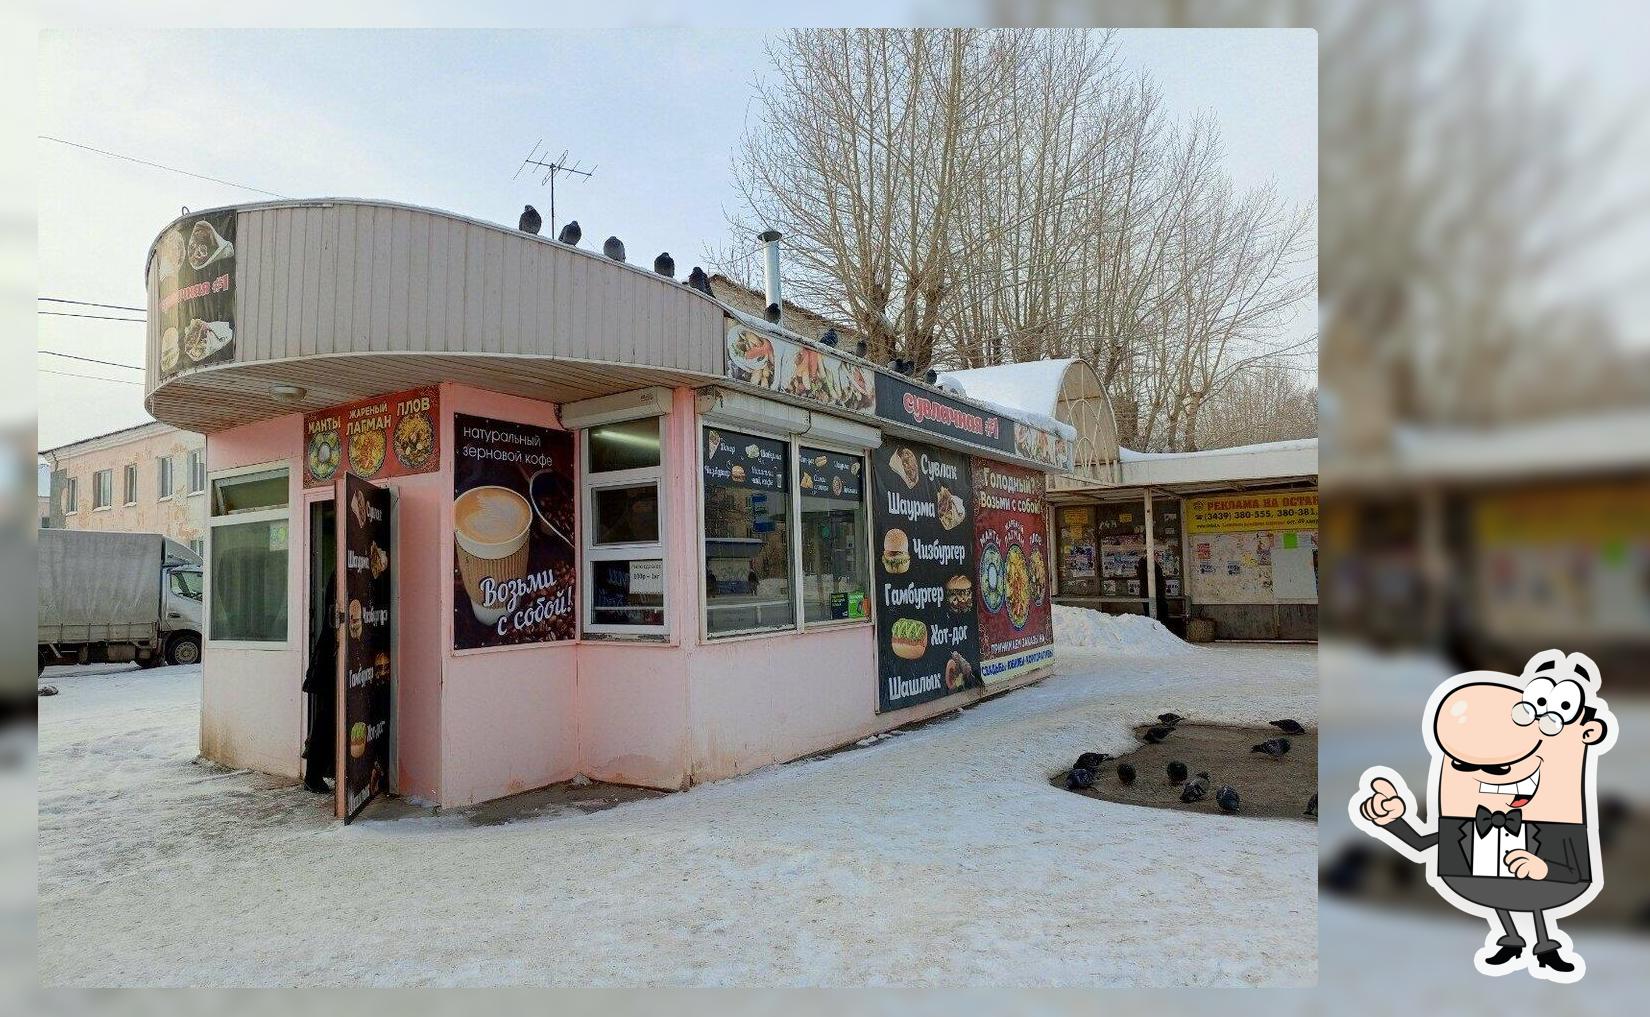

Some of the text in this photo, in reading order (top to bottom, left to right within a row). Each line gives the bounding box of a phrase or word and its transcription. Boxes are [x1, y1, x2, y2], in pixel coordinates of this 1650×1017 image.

[349, 402, 388, 418] ЖАРЕНЫЙ
[397, 397, 431, 417] ПЛОВ
[307, 416, 341, 435] МАНТЫ
[345, 415, 392, 436] ЛАГМАН
[463, 426, 541, 447] натуральный
[462, 443, 553, 469] зерновой кофе
[920, 454, 957, 482] Сувлак
[887, 491, 936, 522] Шаурма
[980, 490, 1011, 511] Возьми
[1011, 499, 1017, 512] с
[1207, 498, 1259, 511] РЕКЛАМА
[1263, 496, 1279, 508] НА
[1204, 511, 1232, 521] (3439)
[1234, 510, 1274, 519] 380-555,
[913, 537, 966, 566] Чизбургер
[480, 569, 557, 612] Возьми
[884, 582, 944, 609] Гамбургер
[497, 586, 573, 636] с собой!
[930, 624, 968, 649] Хот-дог
[888, 671, 941, 701] Шашлык
